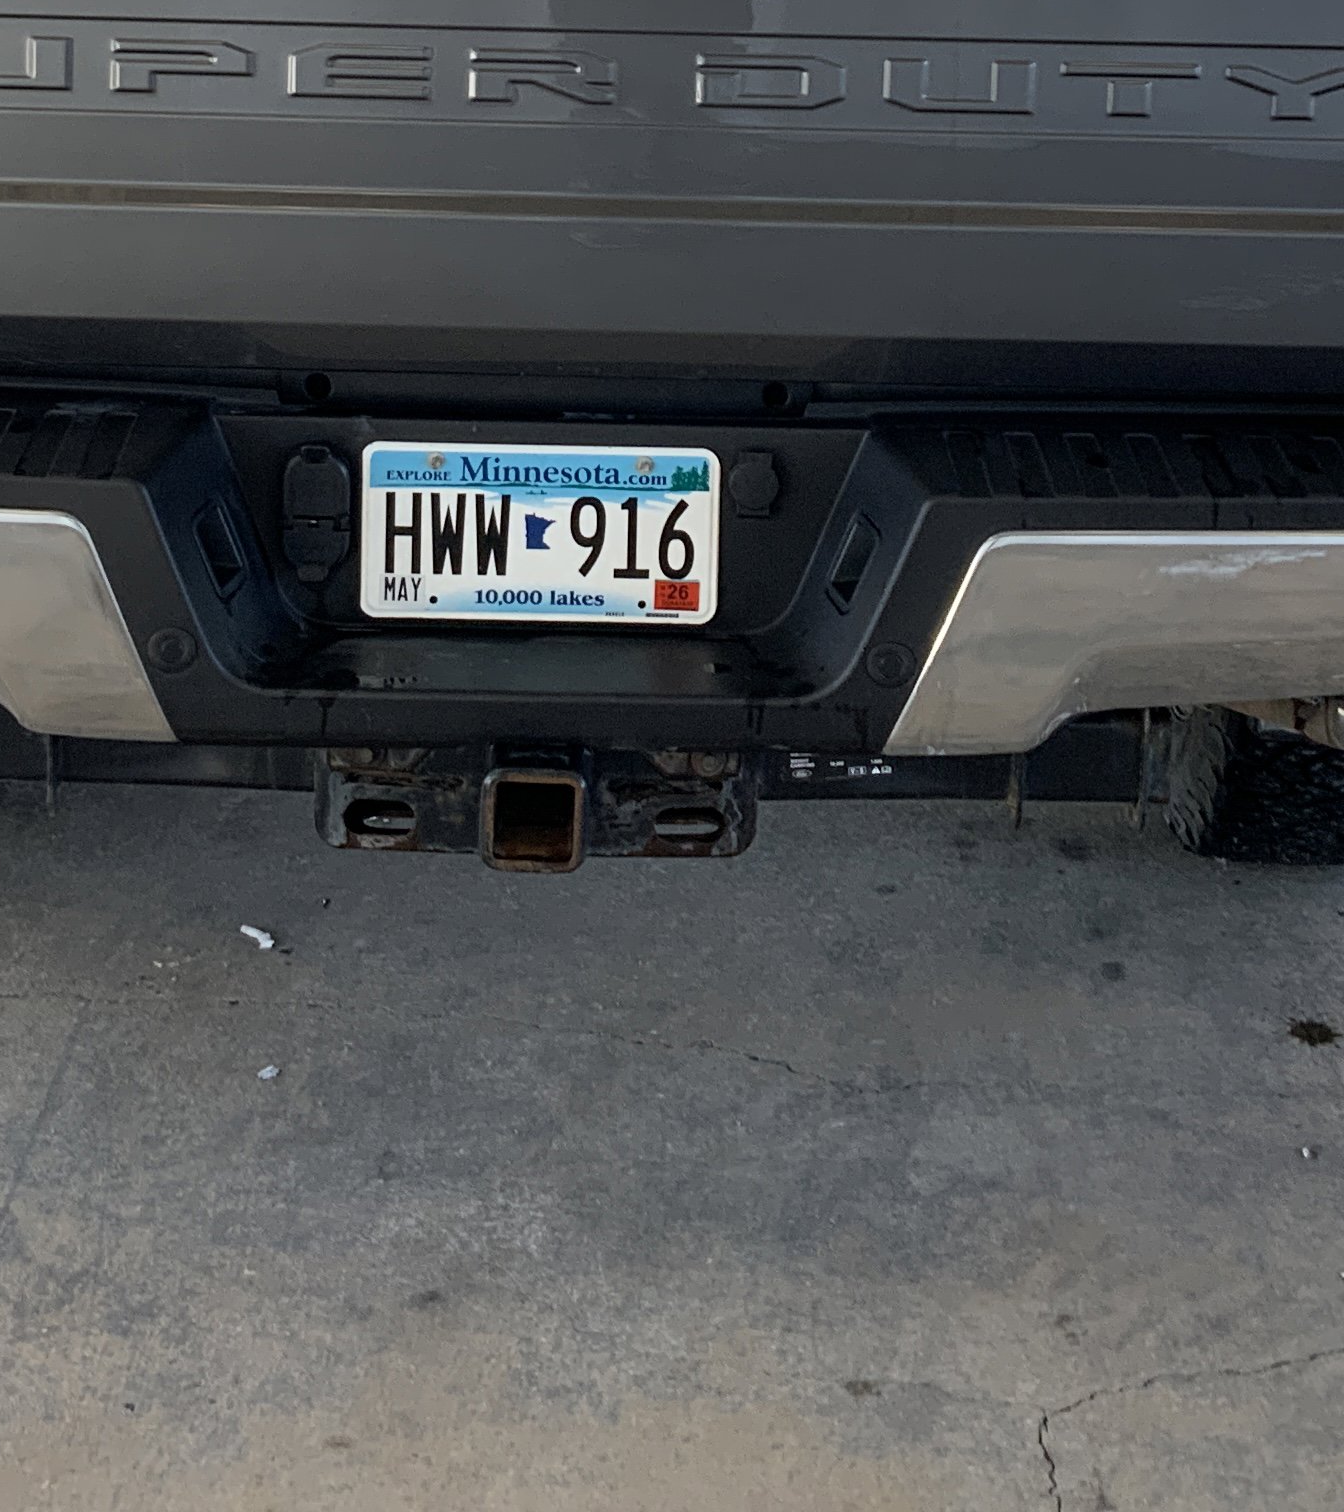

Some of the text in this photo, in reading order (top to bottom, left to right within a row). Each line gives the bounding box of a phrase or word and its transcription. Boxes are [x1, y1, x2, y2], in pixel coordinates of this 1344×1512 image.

[386, 469, 452, 481] EXPLORE
[385, 491, 695, 579] HWW 916
[384, 576, 421, 603] MAY
[474, 589, 605, 607] 10,000 lakes
[667, 584, 689, 600] 26
